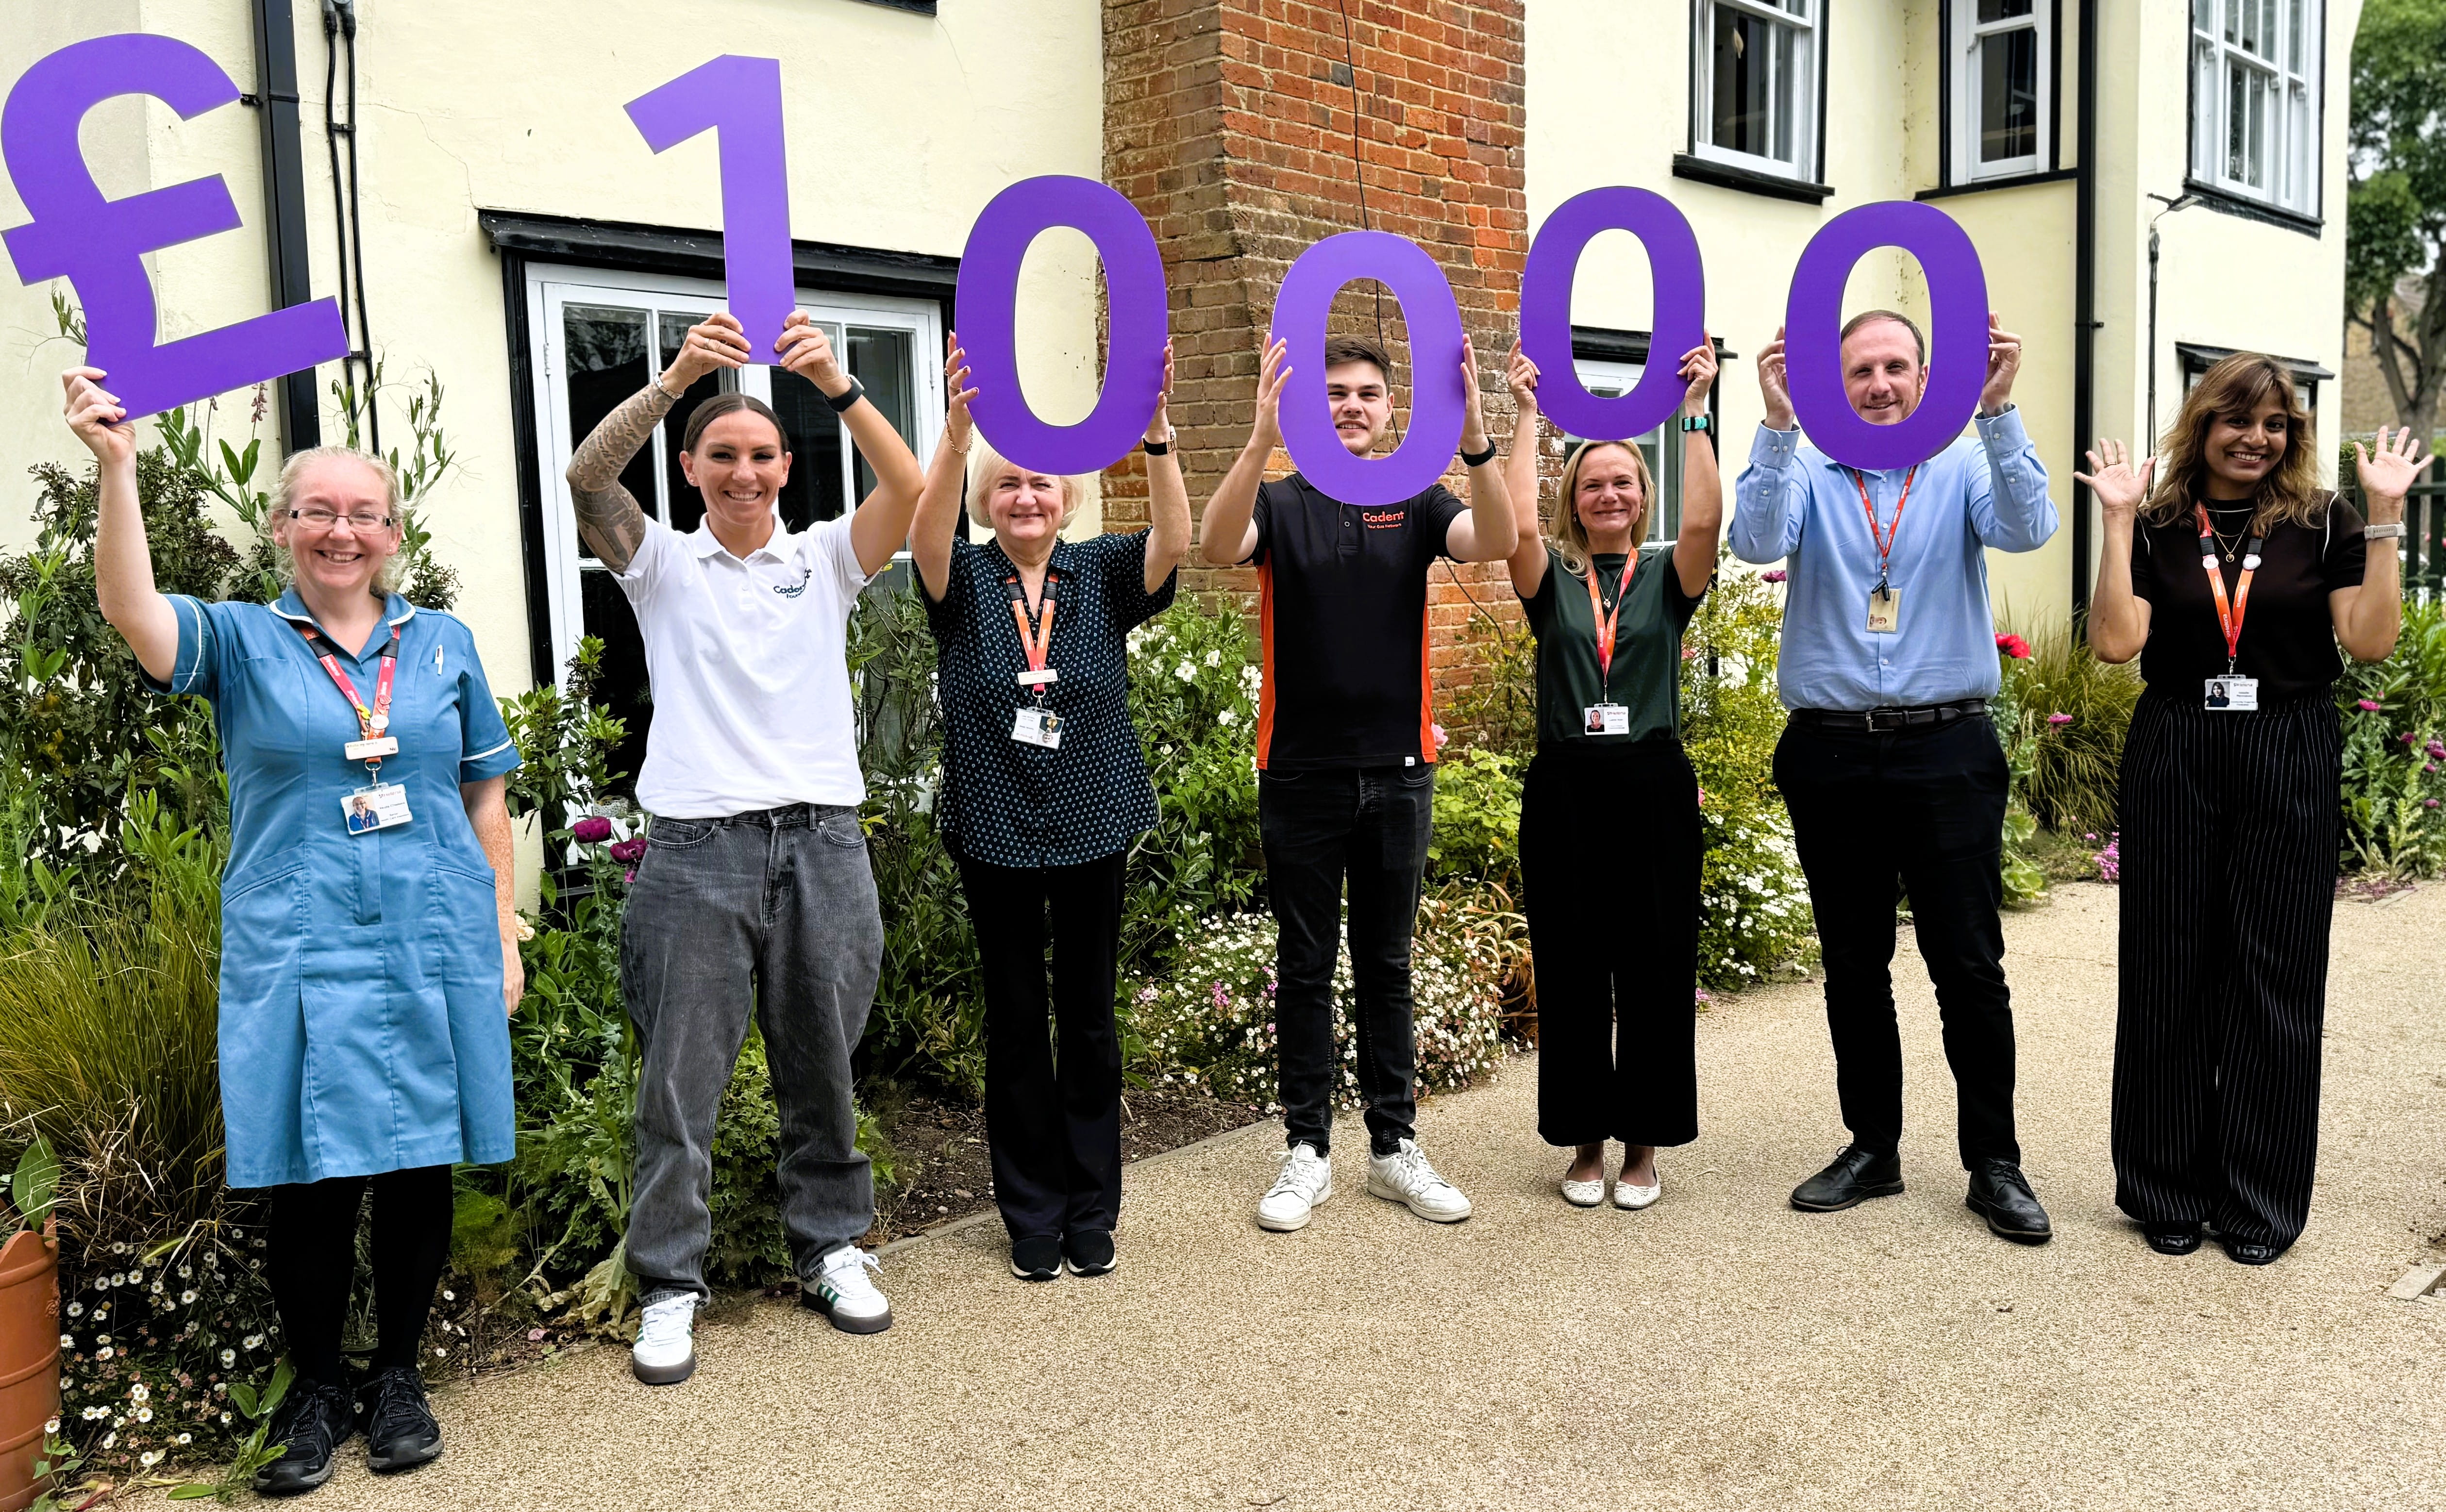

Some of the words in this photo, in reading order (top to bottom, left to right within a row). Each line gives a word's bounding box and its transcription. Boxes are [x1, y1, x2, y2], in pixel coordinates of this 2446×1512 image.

[0, 33, 351, 427] £
[626, 56, 796, 366] 1
[1362, 511, 1405, 522] Cadent
